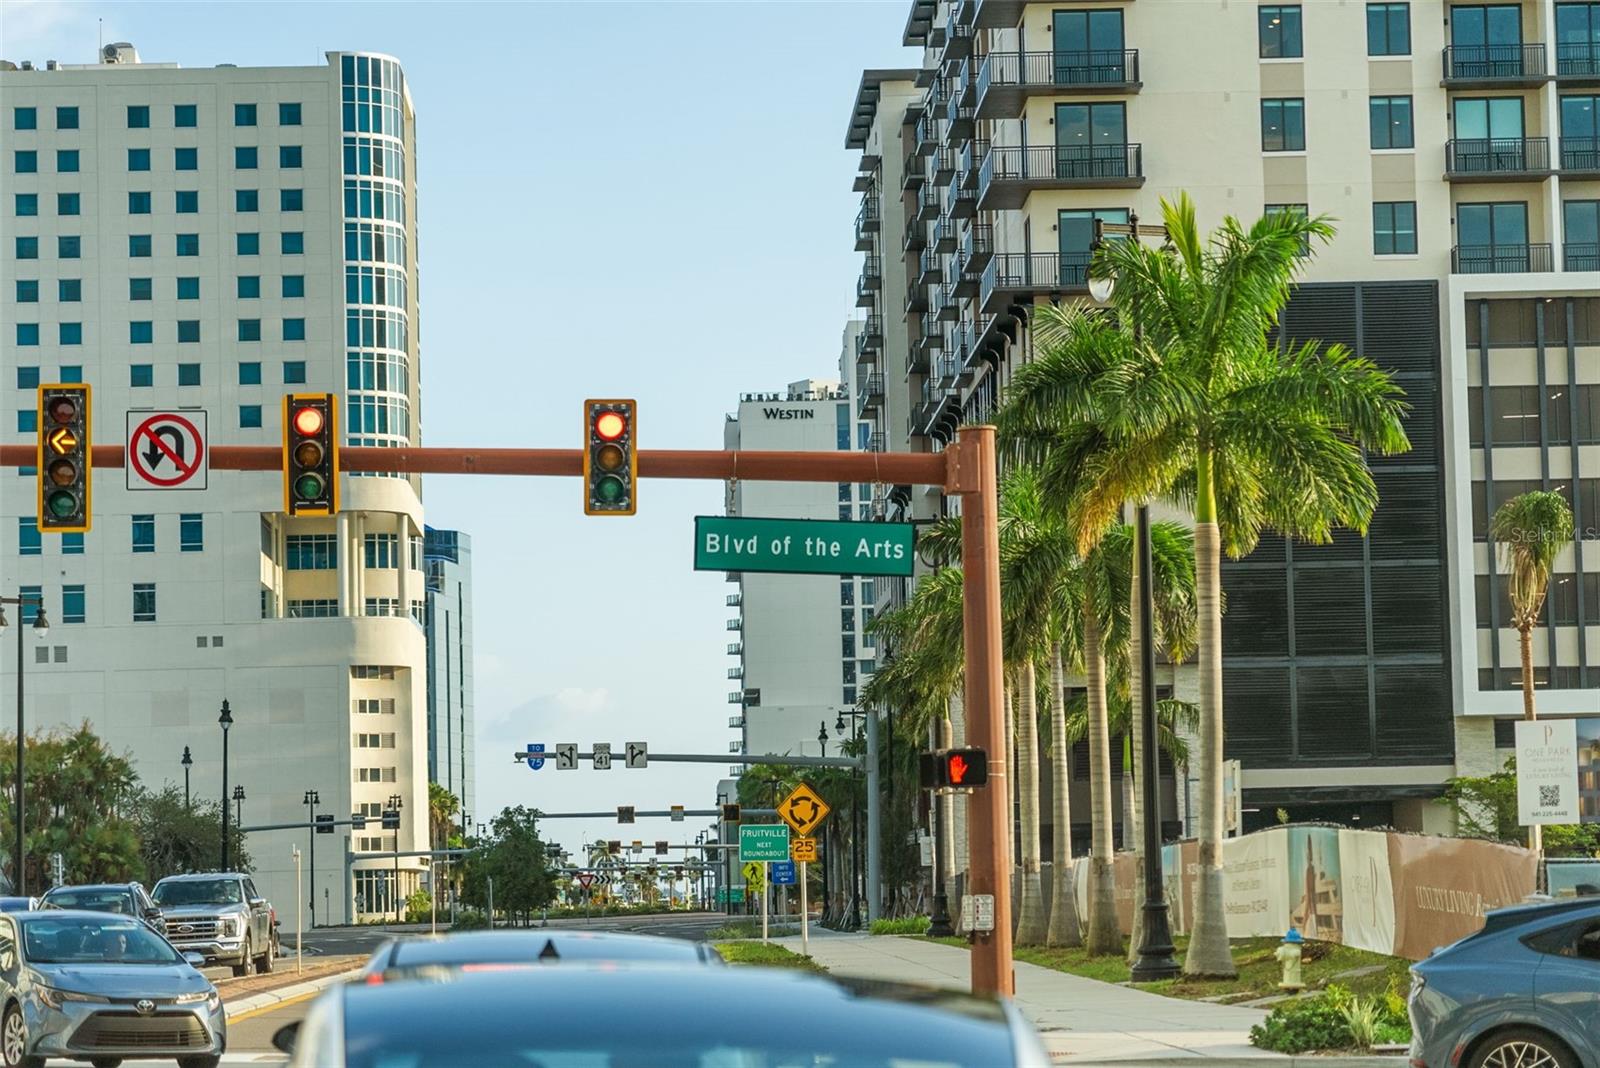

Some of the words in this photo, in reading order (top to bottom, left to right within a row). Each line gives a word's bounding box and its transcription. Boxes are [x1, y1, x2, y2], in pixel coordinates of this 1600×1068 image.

[705, 533, 758, 555] Blvd
[770, 535, 791, 556] of
[804, 537, 841, 557] the
[854, 538, 904, 560] Arts
[530, 758, 543, 767] 75
[596, 755, 608, 766] 41
[742, 829, 786, 837] FRUITVILLE
[795, 841, 814, 853] 25
